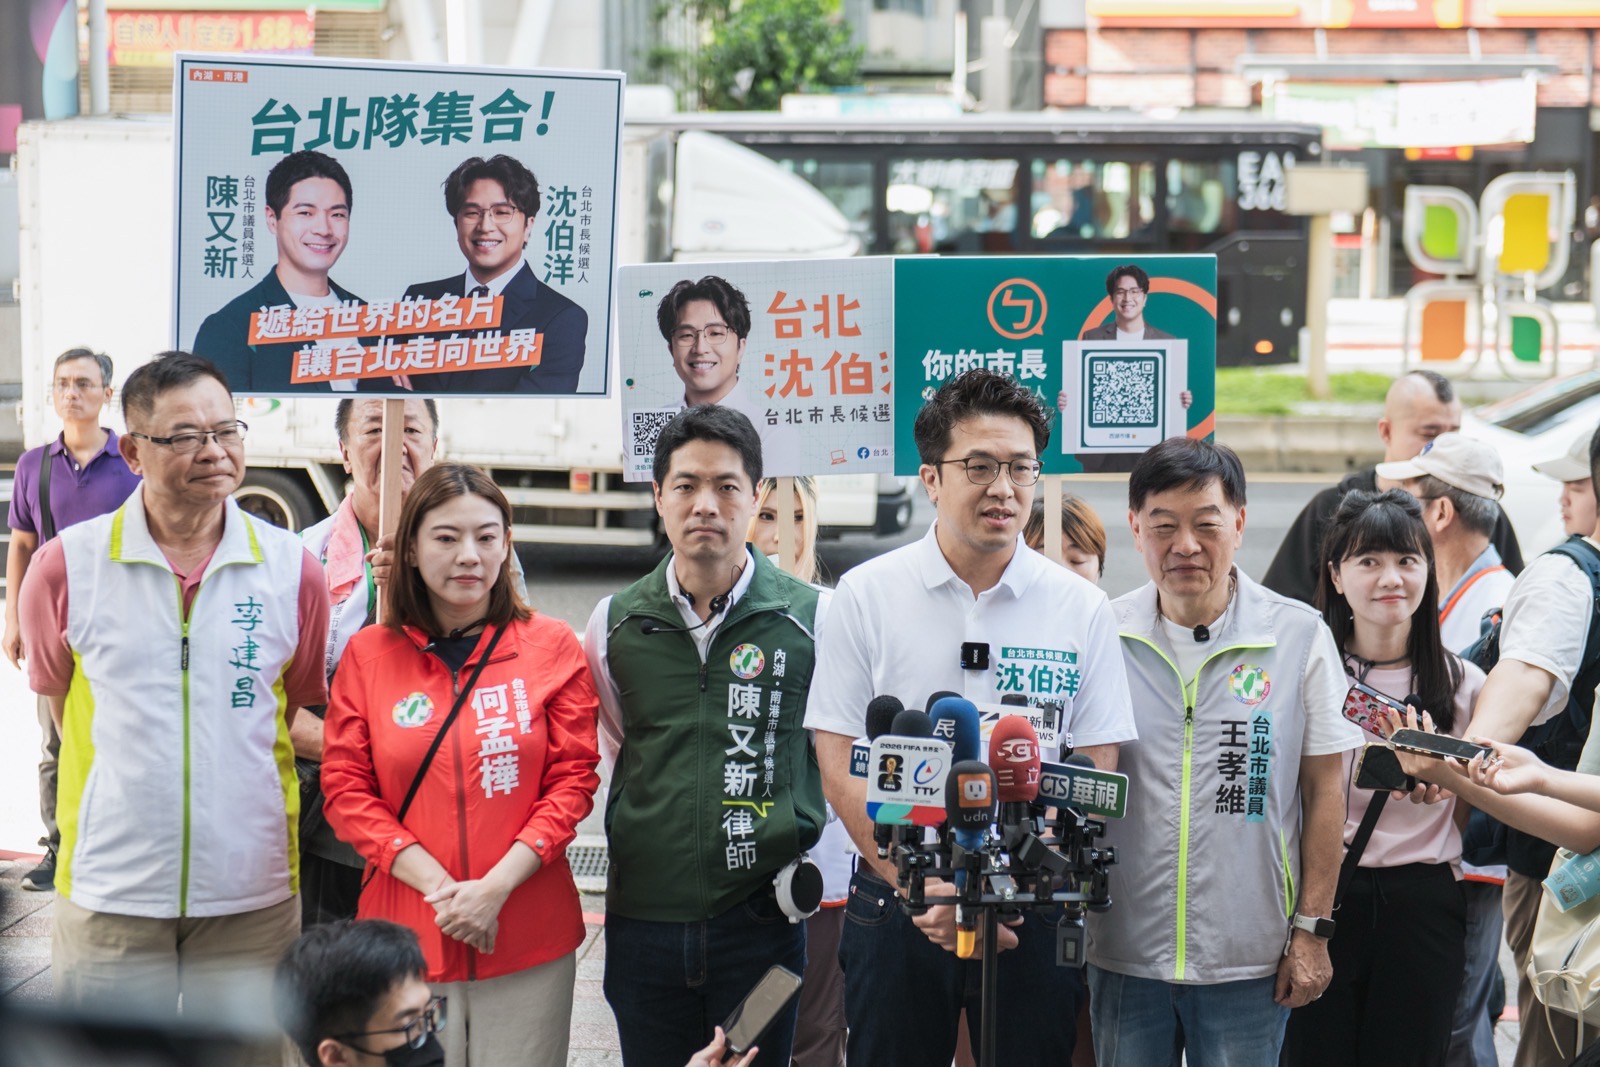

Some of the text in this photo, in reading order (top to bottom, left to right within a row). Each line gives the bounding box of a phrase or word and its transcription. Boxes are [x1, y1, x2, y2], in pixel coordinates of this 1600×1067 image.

[204, 175, 239, 279] 陳又新
[241, 175, 256, 279] 台北市議員候選人
[543, 185, 577, 286] 沈伯洋
[577, 185, 593, 284] 台北市長候選人
[255, 291, 496, 339] 遞給世界的名片
[766, 290, 862, 339] 台北
[297, 328, 537, 378] 讓台北走向世界
[921, 348, 1047, 381] 你的市長
[229, 596, 263, 708] 李建昌
[1007, 649, 1072, 662] 台北市長候選人
[995, 663, 1080, 697] 沈伯洋
[471, 683, 519, 798] 何孟樺
[723, 683, 762, 797] 陳又新
[903, 744, 921, 752] FIFA
[998, 767, 1039, 786] 三立
[1215, 720, 1248, 815] 王孝維
[1247, 715, 1270, 816] 台北市議員
[913, 786, 940, 796] TTV
[1040, 775, 1118, 811] CTS 華視
[722, 808, 757, 871] 律師
[963, 811, 989, 823] udn
